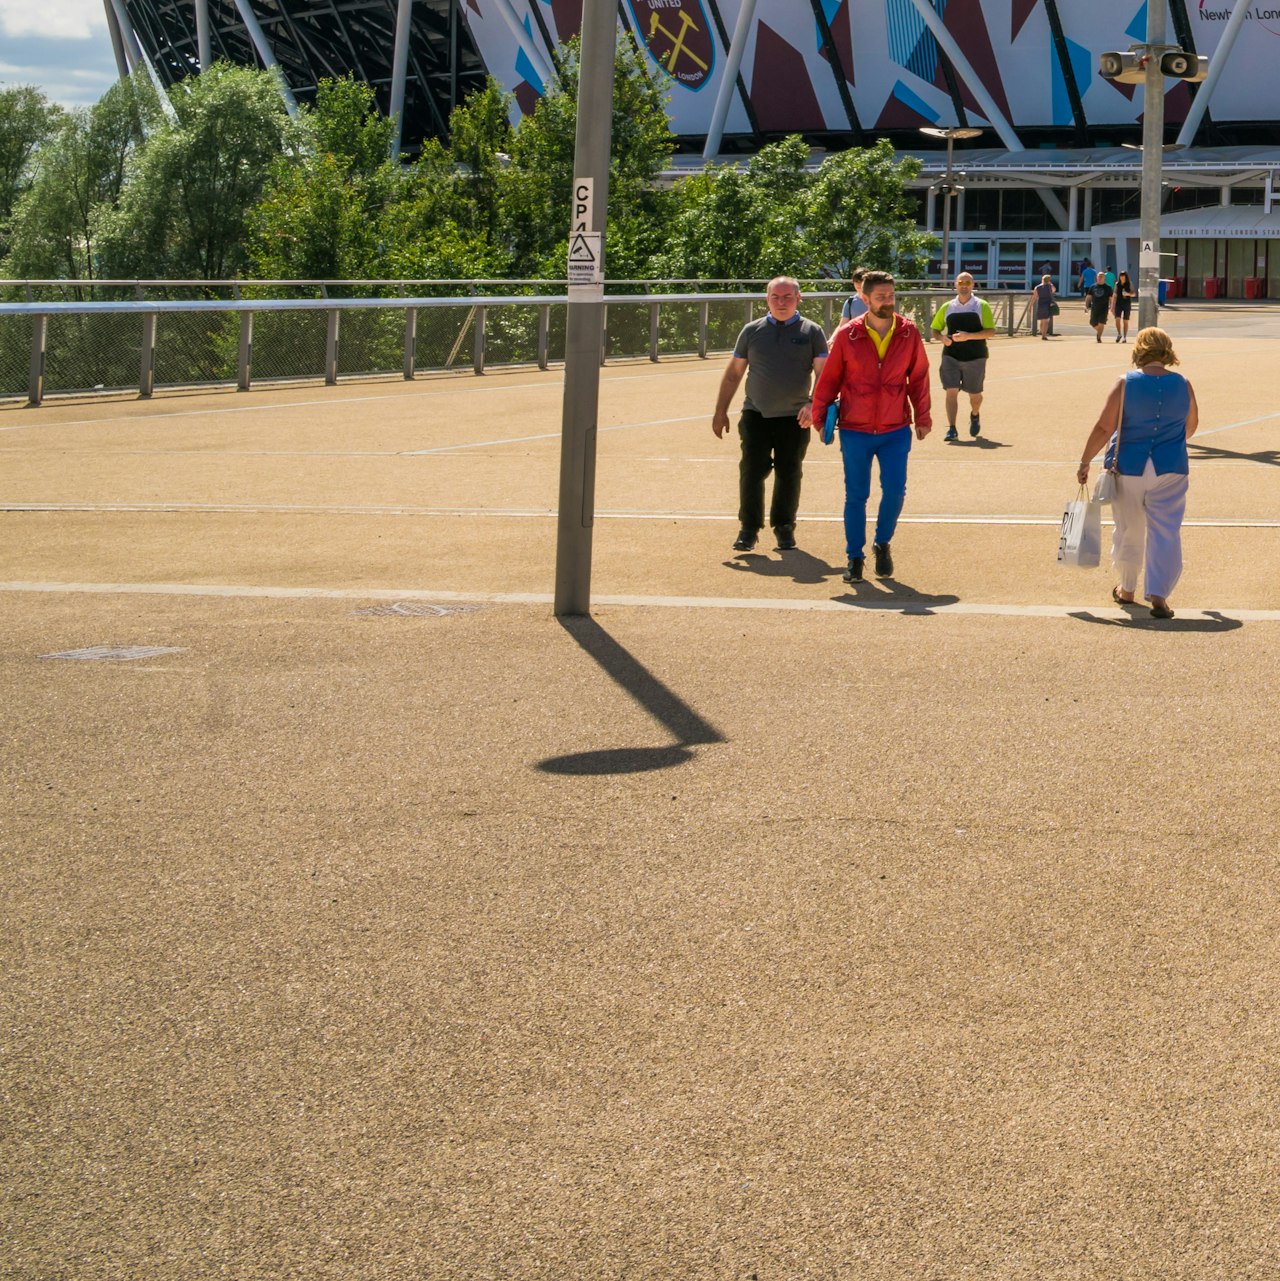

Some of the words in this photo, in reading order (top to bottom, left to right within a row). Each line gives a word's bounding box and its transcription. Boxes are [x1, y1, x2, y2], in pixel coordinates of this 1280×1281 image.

[647, 0, 682, 9] UNITED
[1200, 8, 1252, 21] Newhm
[677, 71, 704, 80] LONDON
[1144, 243, 1151, 251] A
